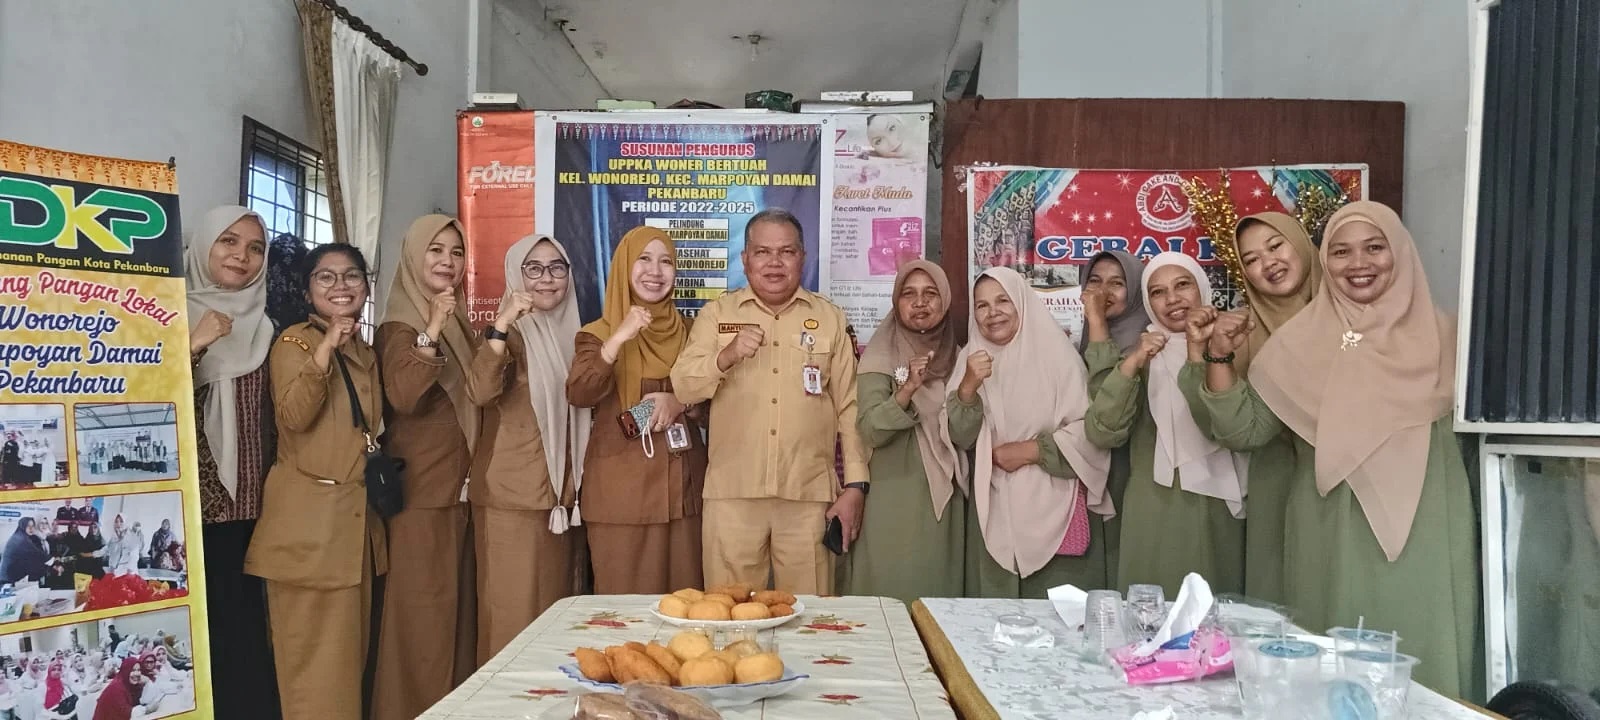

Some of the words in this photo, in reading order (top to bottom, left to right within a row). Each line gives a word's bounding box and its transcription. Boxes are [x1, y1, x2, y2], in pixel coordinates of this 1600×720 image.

[620, 142, 683, 156] SUSUNAN
[685, 143, 756, 157] PENGURUS
[608, 159, 652, 170] UPPKA
[656, 159, 703, 171] WONER
[707, 160, 767, 171] BERTUAH
[559, 172, 585, 184] KEL.
[588, 173, 663, 185] WONOREJO,
[666, 174, 694, 185] KEC.
[698, 174, 770, 186] MARPOYAN
[773, 175, 817, 186] DAMAI
[647, 188, 728, 200] PEKANBARU
[621, 202, 677, 213] PERIODE
[680, 202, 755, 213] 2022-2025
[834, 205, 876, 213] Kecantikan
[668, 219, 705, 229] PELINDUNG
[669, 230, 705, 240] MARPOYAN
[706, 231, 727, 240] DAMAI
[36, 252, 80, 267] Pangan
[84, 257, 110, 269] Kota
[114, 259, 170, 274] Pekanbaru
[677, 260, 725, 269] WONOREJO
[674, 278, 706, 287] MBINA
[0, 277, 30, 299] ng
[39, 271, 119, 303] Pangan
[120, 288, 178, 326] Lokal
[674, 289, 696, 298] PLKB
[0, 305, 121, 338] Wonorejo
[86, 340, 162, 364] Damai
